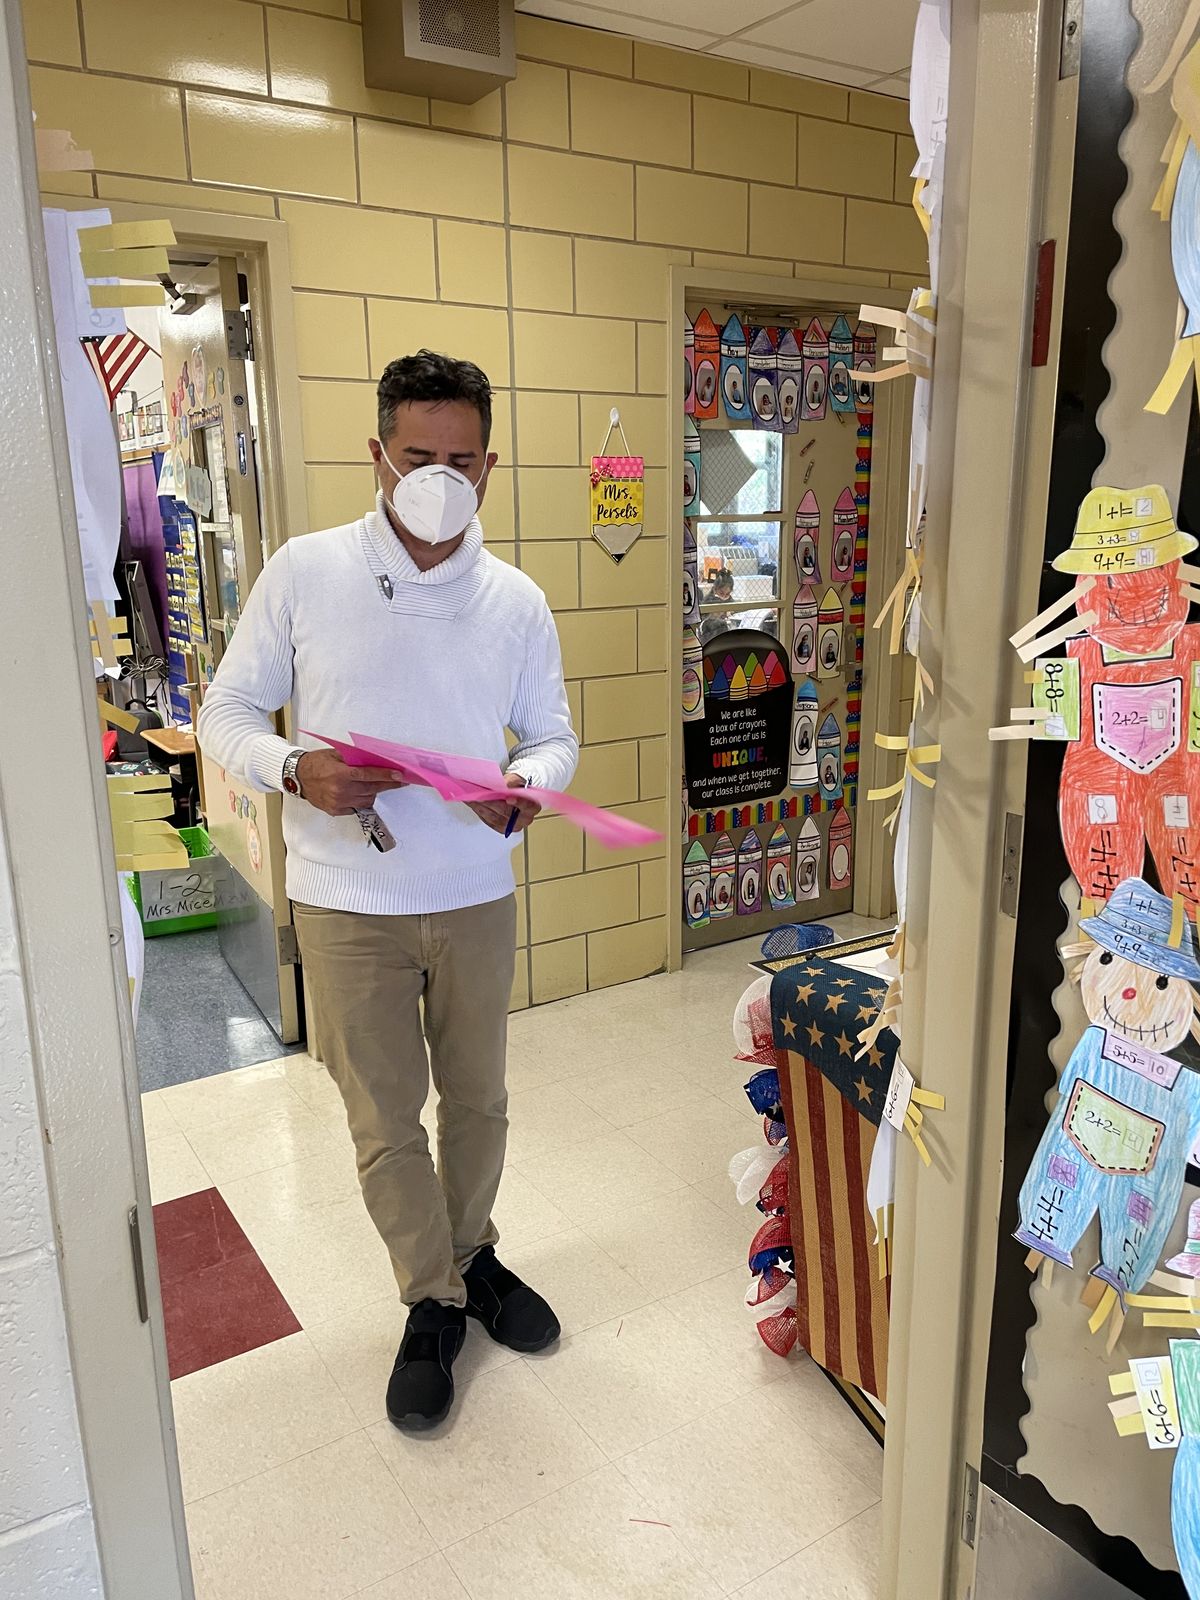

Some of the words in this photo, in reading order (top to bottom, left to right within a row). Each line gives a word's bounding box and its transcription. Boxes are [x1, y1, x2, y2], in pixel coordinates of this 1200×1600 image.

[604, 484, 632, 501] Mrs.
[597, 502, 638, 521] Perselis
[721, 711, 731, 720] We
[732, 710, 744, 718] are
[745, 708, 757, 717] like
[716, 724, 728, 733] box
[729, 722, 737, 730] of
[739, 719, 767, 731] crayons
[710, 736, 728, 746] Each
[729, 735, 741, 743] one
[742, 732, 750, 741] of
[751, 732, 759, 740] us
[760, 731, 767, 739] is
[692, 778, 706, 788] and
[707, 775, 726, 786] when
[728, 774, 737, 782] we
[739, 772, 749, 784] get
[702, 790, 714, 799] our
[715, 787, 734, 797] class
[735, 785, 740, 793] is
[741, 780, 771, 792] complete
[147, 903, 174, 919] Mrs.
